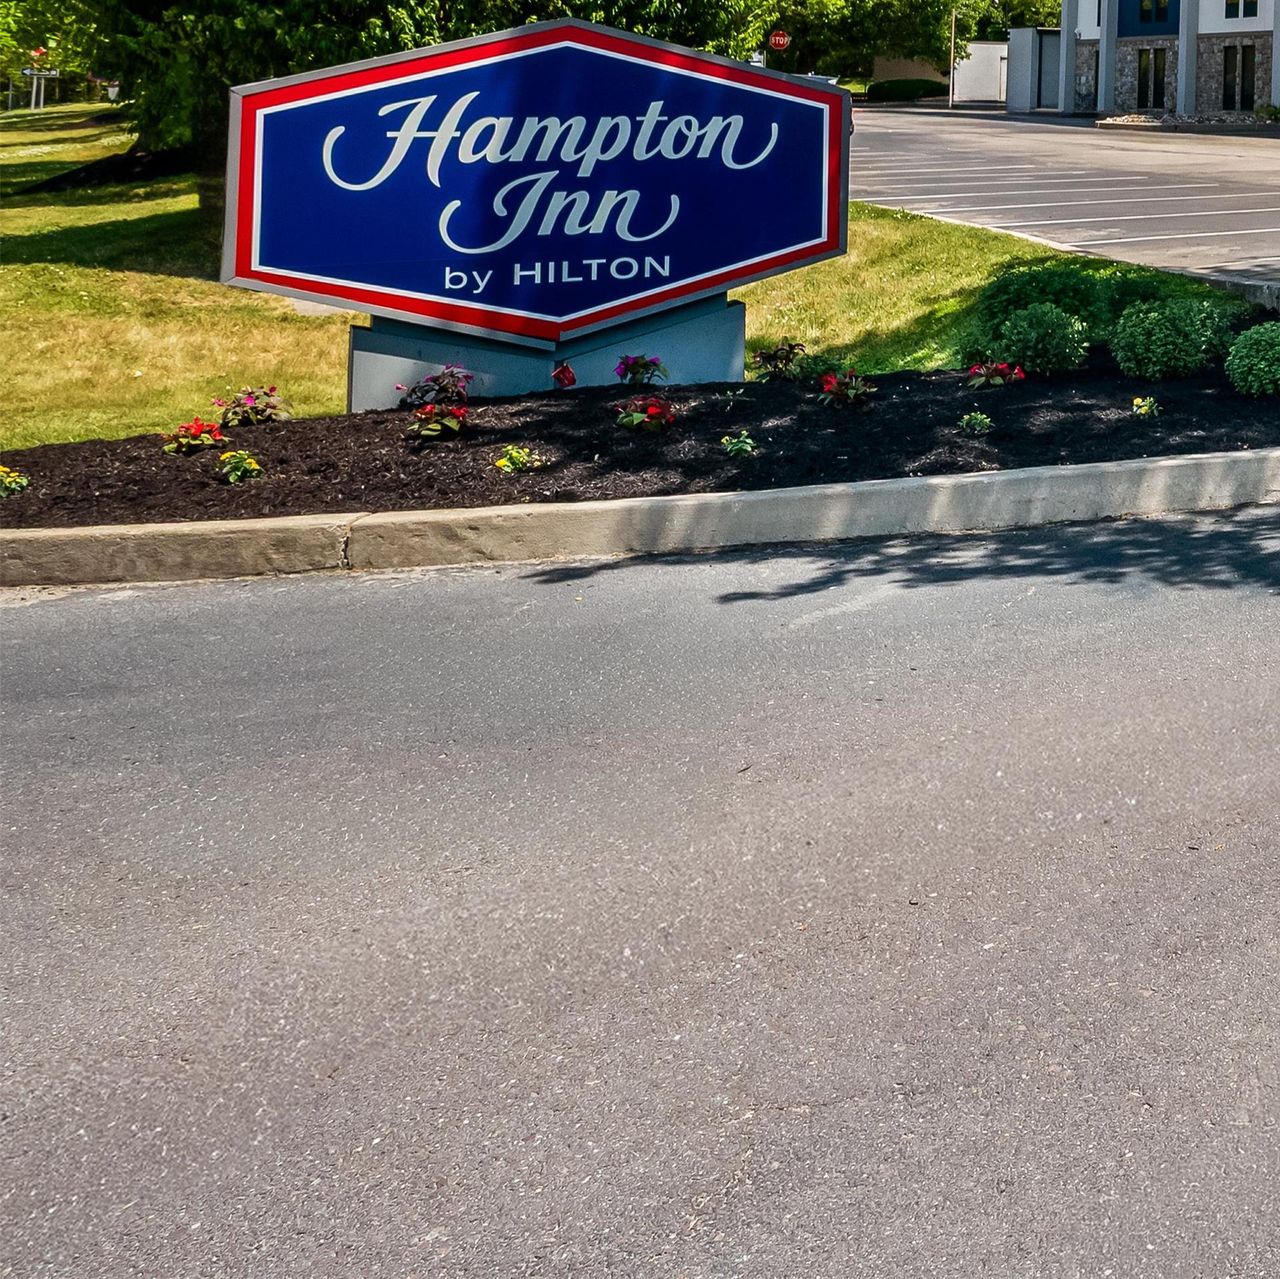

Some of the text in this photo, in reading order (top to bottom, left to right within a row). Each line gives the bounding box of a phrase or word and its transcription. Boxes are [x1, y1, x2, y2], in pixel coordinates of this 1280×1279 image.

[771, 36, 788, 45] STOP
[322, 91, 779, 191] Hampton
[438, 170, 681, 254] Inn
[444, 255, 671, 294] by HILTON
